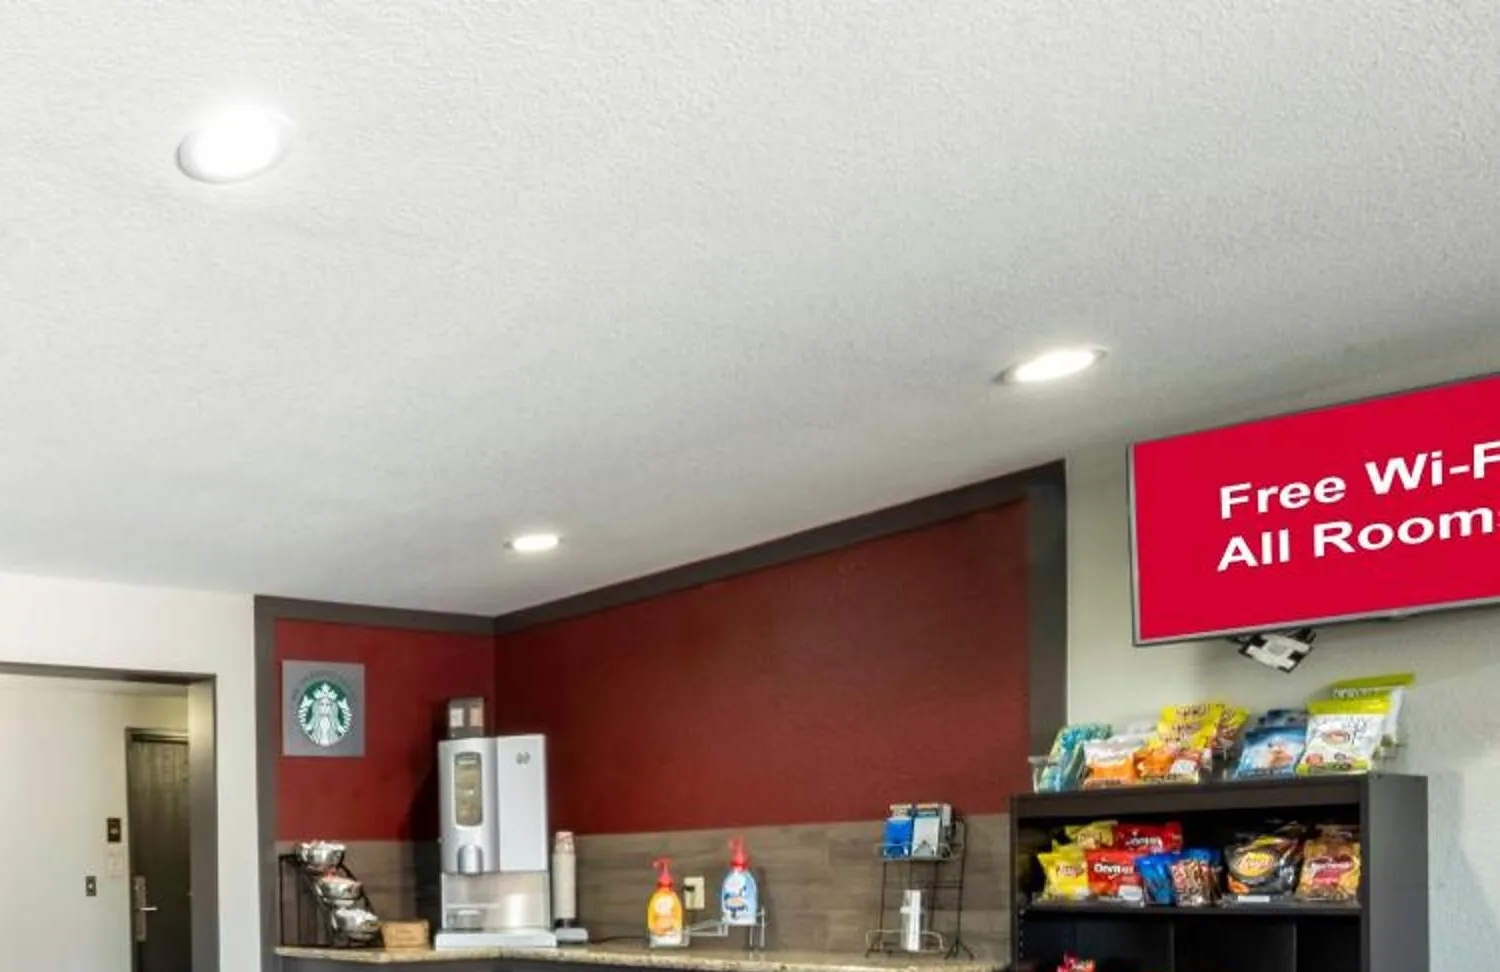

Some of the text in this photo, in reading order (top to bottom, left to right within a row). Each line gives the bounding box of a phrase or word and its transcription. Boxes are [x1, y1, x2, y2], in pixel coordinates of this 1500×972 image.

[1220, 475, 1346, 520] Free
[1217, 506, 1500, 572] All Room
